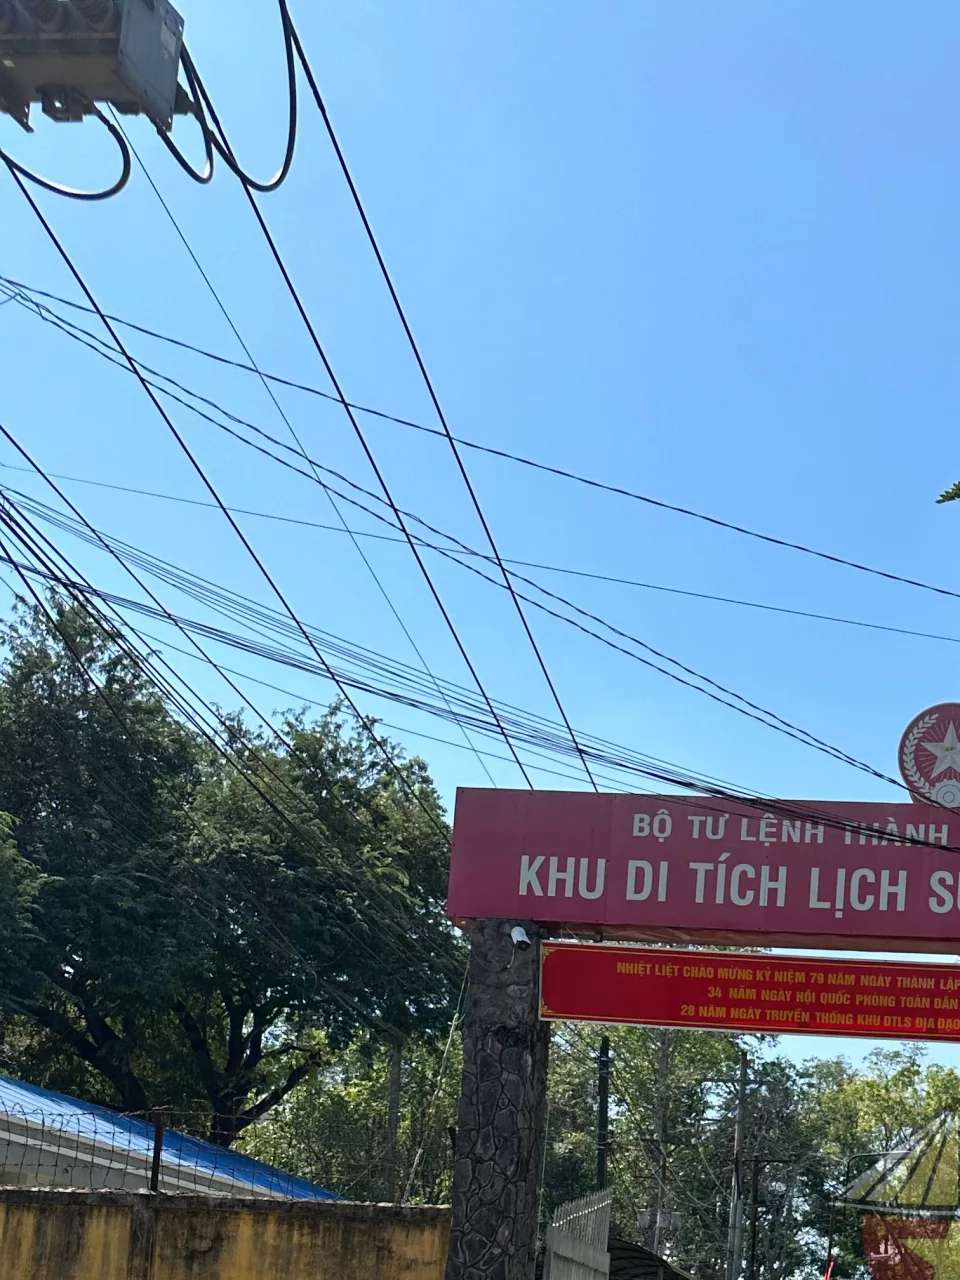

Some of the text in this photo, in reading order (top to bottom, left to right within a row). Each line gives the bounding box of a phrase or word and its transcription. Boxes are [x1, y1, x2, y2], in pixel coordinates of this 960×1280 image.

[632, 808, 672, 842] BỘ
[687, 813, 730, 840] TƯ
[740, 812, 824, 847] LỆNH
[844, 816, 949, 848] THÀNH
[518, 855, 606, 900] KHU
[625, 859, 669, 902] DI
[689, 852, 788, 907] TÍCH
[808, 867, 908, 918] LỊCH
[616, 961, 652, 977] NHIỆT
[655, 963, 680, 978] LIỆT
[683, 964, 714, 979] CHÀO
[717, 965, 753, 981] MỪNG
[756, 966, 772, 982] KỶ
[774, 968, 806, 984] NIỆM
[809, 972, 825, 984] 79
[827, 971, 855, 986] NĂM
[860, 974, 892, 988] NGÀY
[896, 975, 935, 989] THÀNH
[707, 986, 722, 998] 34
[729, 986, 757, 1000] NĂM
[761, 988, 792, 1002] NGÀY
[796, 989, 816, 1004] HỘI
[820, 989, 851, 1005] QUỐC
[856, 993, 896, 1007] PHÒNG
[900, 995, 930, 1009] TOÀN
[934, 995, 958, 1010] DÂN
[680, 1004, 695, 1016] 28
[699, 1004, 726, 1018] NĂM
[730, 1006, 762, 1020] NGÀY
[765, 1006, 810, 1022] TRUYỀN
[815, 1009, 853, 1025] THỐNG
[857, 1014, 881, 1027] KHU
[915, 1017, 935, 1032] ĐỊA
[937, 1017, 960, 1033] ĐẠO
